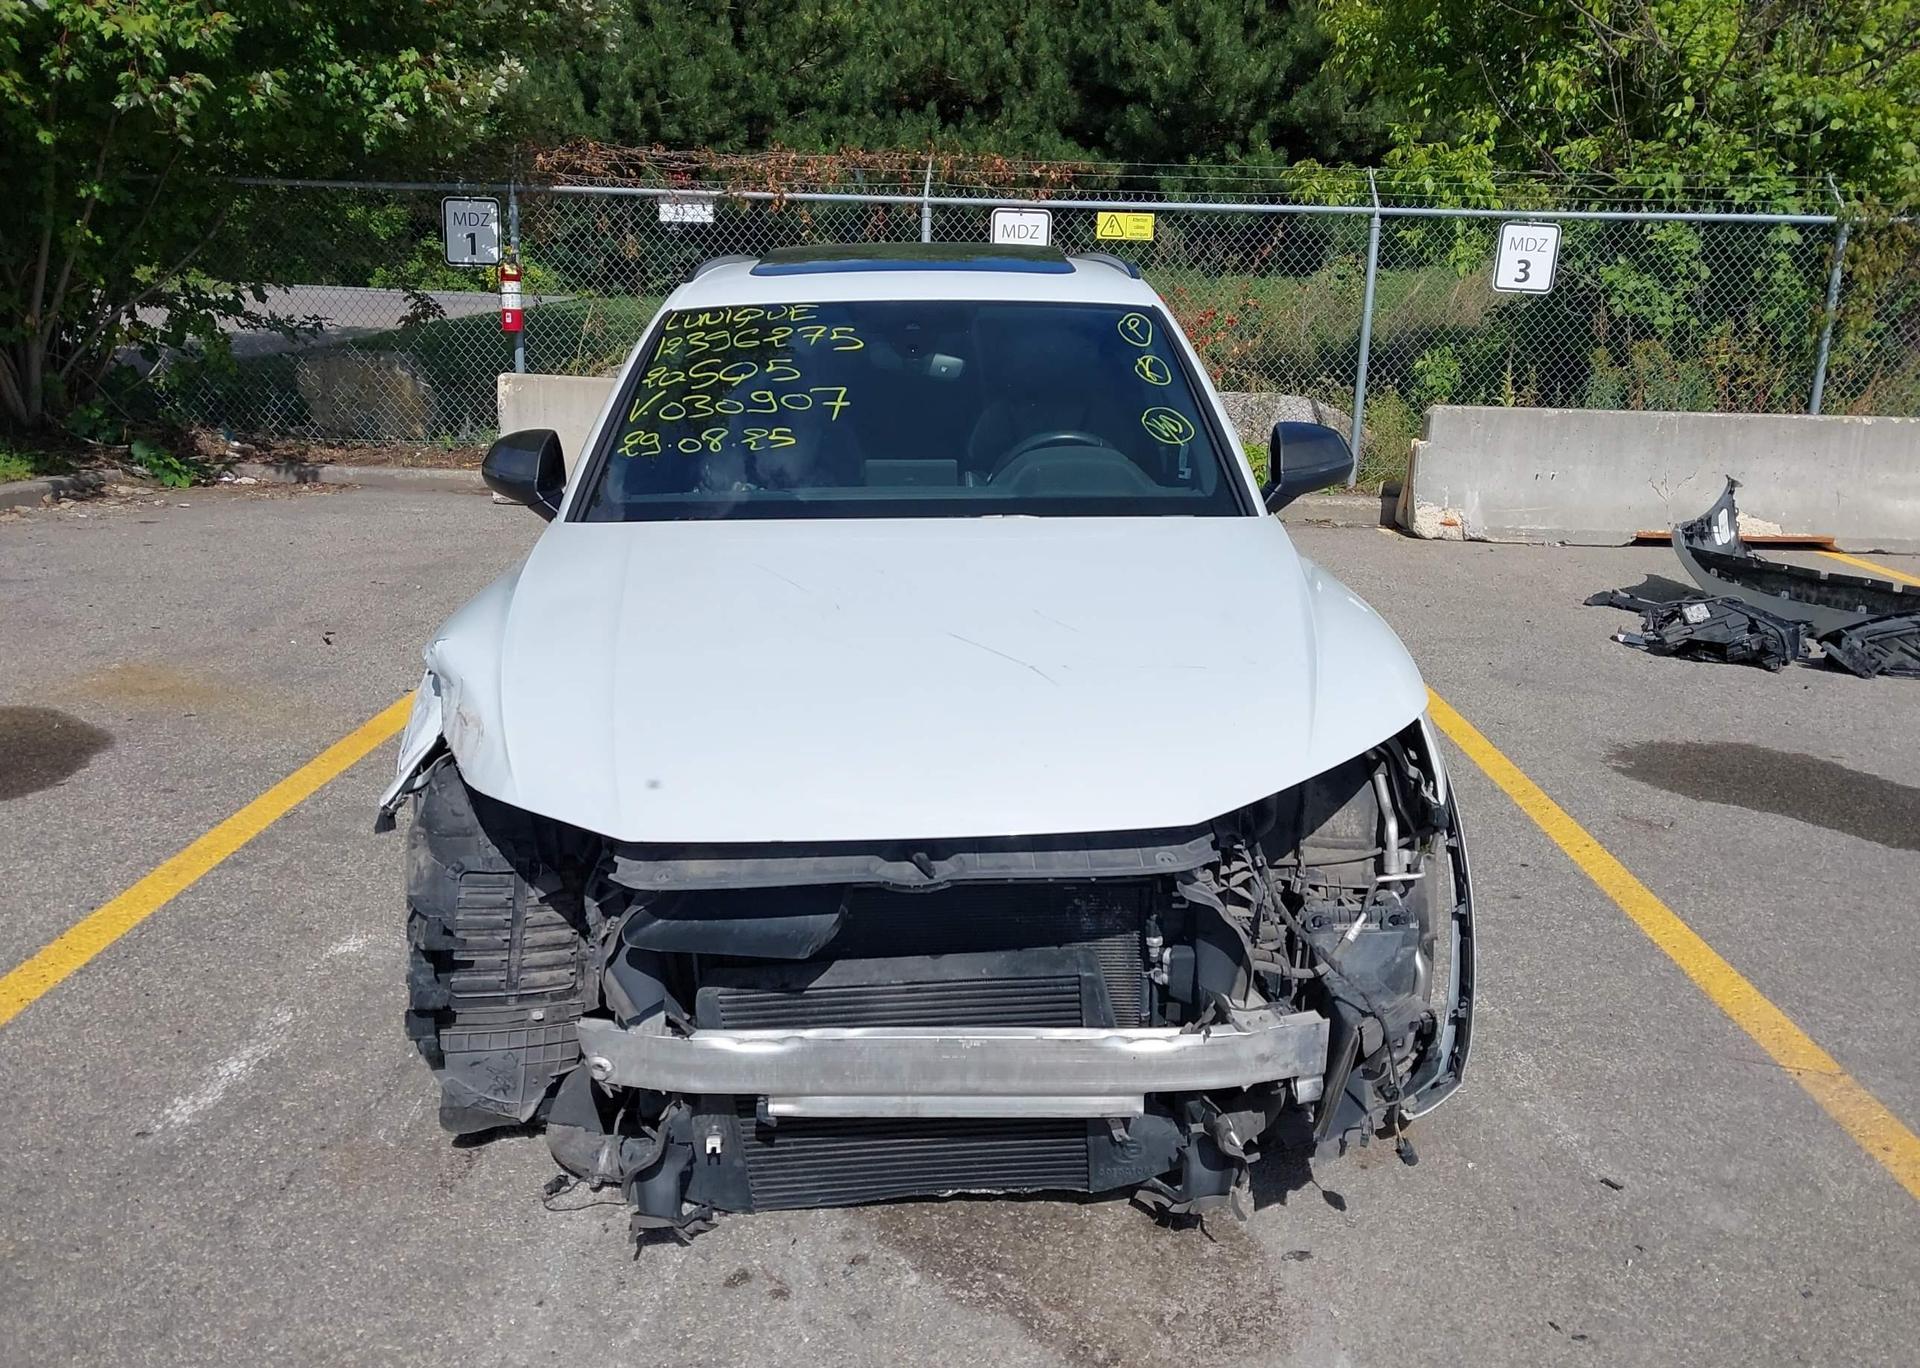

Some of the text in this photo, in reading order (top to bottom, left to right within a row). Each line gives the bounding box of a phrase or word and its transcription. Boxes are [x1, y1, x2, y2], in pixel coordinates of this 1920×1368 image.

[453, 212, 490, 228] MDZ
[1002, 223, 1040, 240] MDZ
[466, 232, 477, 256] 1
[1509, 236, 1549, 253] MDZ
[1513, 259, 1532, 284] 3
